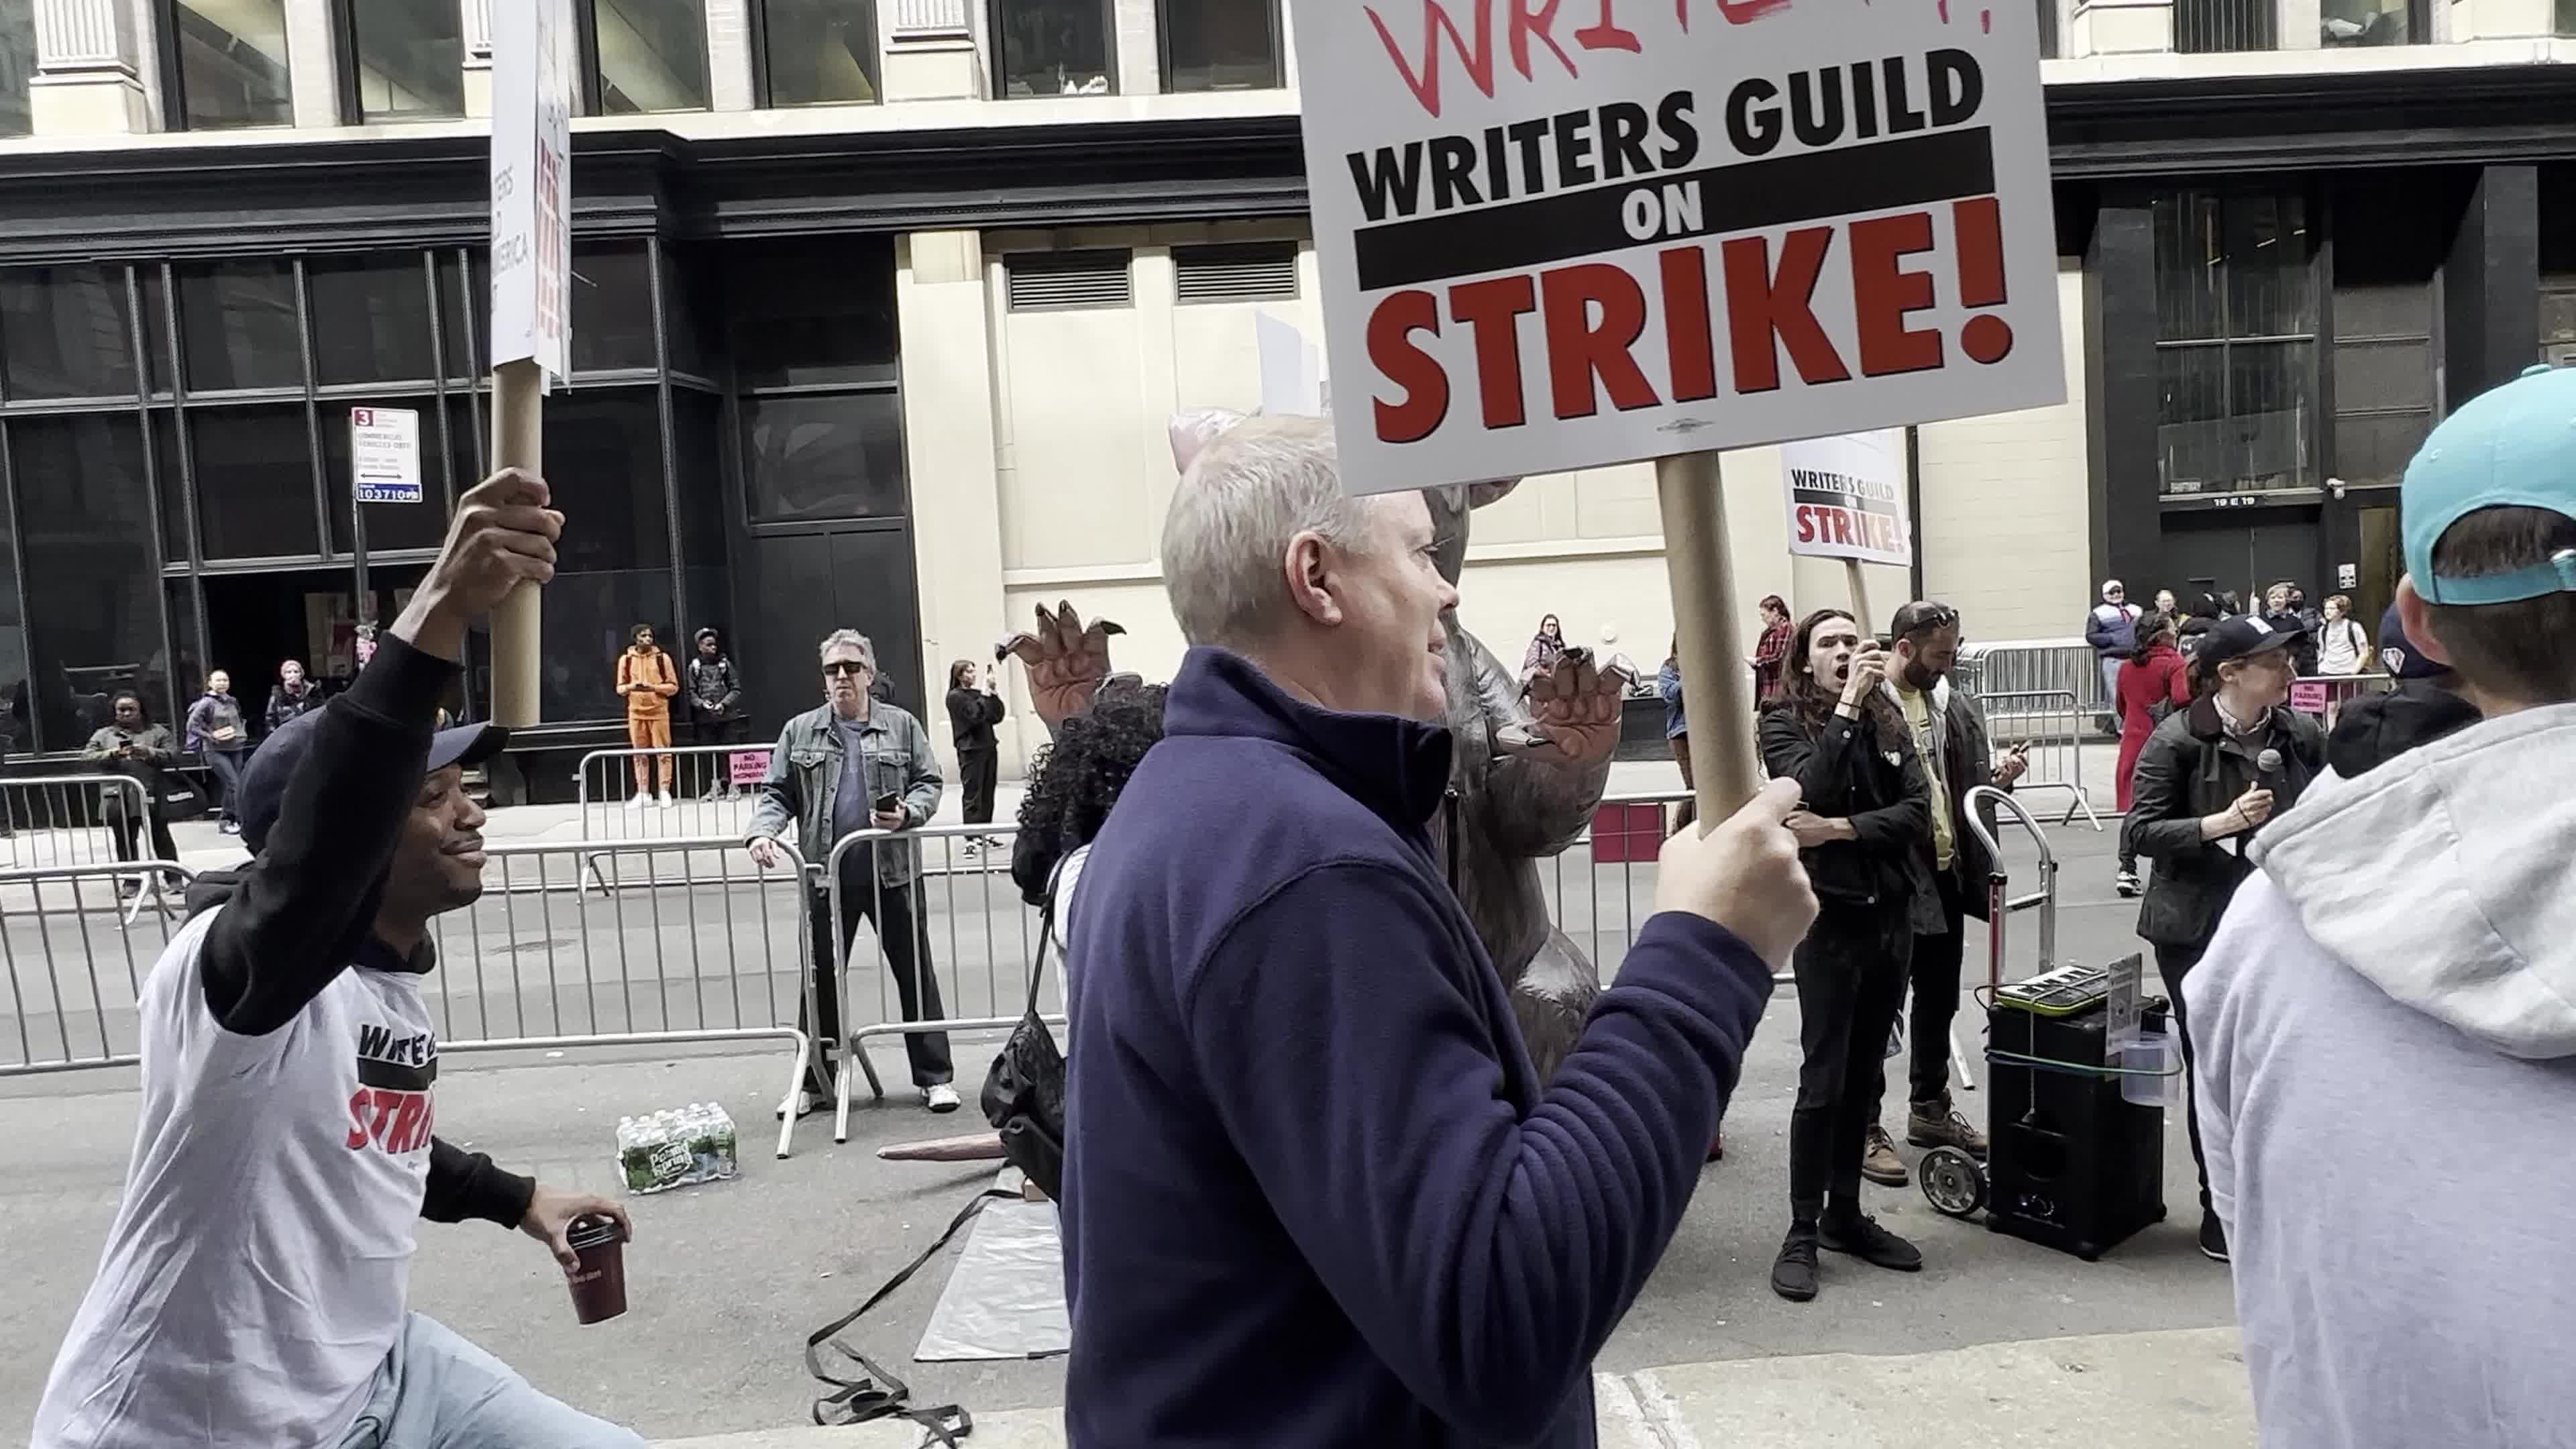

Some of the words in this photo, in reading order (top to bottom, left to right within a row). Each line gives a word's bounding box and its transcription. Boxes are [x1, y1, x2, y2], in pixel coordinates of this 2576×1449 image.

[1346, 91, 1699, 222] WRITERS
[1726, 48, 1984, 156] GUILD
[1621, 180, 1703, 240] ON
[1366, 197, 2013, 444] STRIKE!
[358, 411, 370, 425] 3
[1790, 468, 1855, 494] WRITERS
[1796, 504, 1905, 553] STRIKE!
